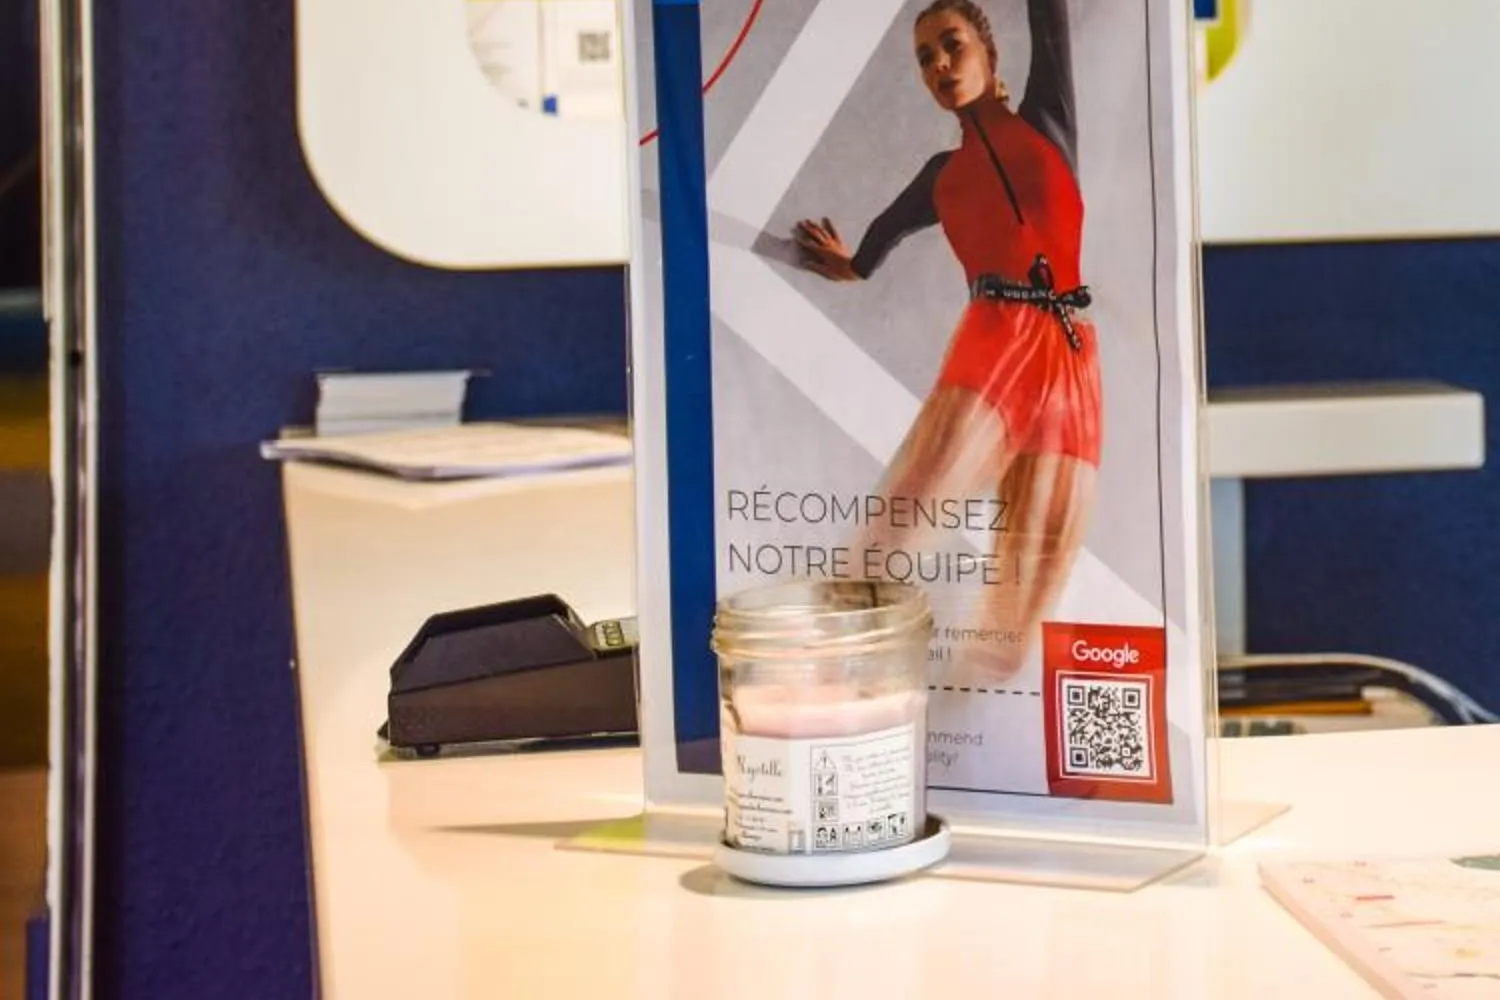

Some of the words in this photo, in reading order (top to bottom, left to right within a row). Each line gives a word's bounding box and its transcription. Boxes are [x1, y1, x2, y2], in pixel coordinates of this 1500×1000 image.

[726, 484, 1010, 532] RÉCOMPENSEZ
[728, 543, 851, 578] NOTRE
[862, 542, 1001, 586] ÉQUIPE
[1071, 639, 1141, 669] Google
